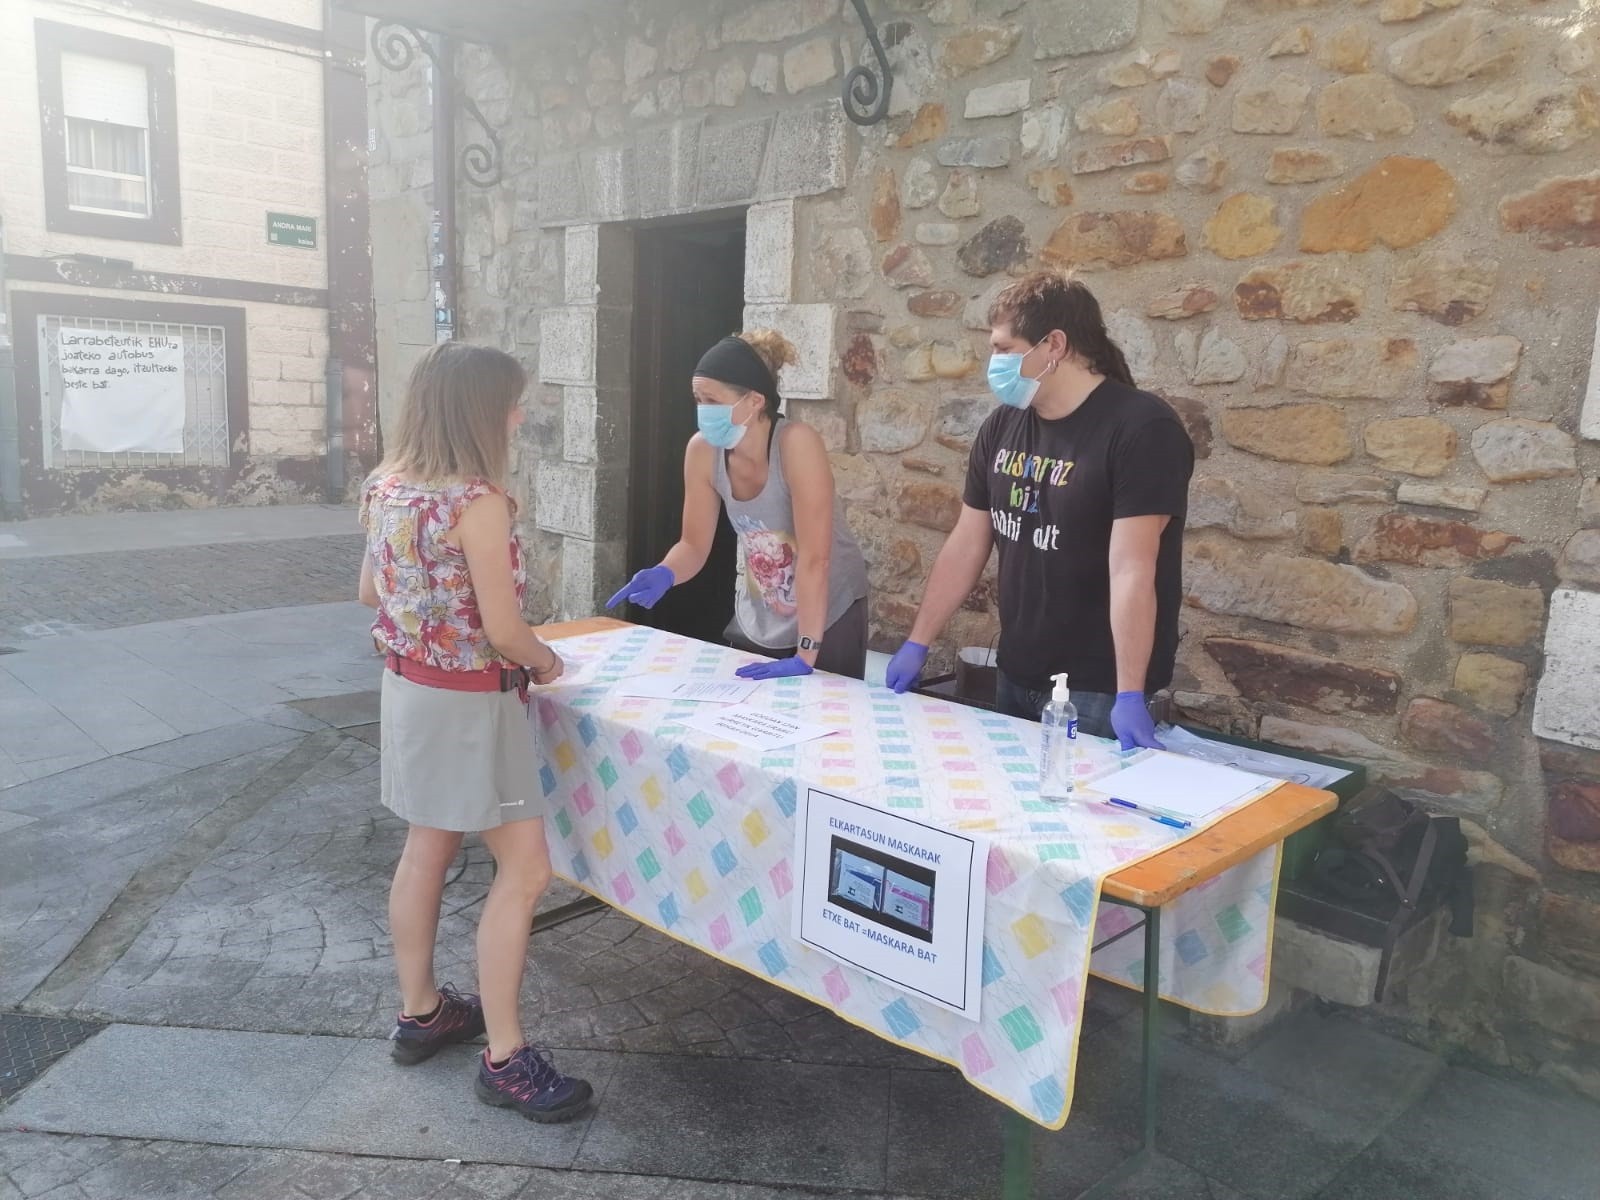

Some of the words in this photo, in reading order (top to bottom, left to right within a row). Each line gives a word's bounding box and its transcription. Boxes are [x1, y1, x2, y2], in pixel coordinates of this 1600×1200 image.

[61, 349, 102, 361] joateko
[108, 348, 154, 360] autobus
[64, 378, 88, 390] beste
[829, 817, 886, 846] ELKARTASUN
[887, 838, 941, 865] MASKARAK
[822, 908, 843, 925] ETXE
[843, 915, 861, 934] BAT
[917, 948, 937, 965] BAT
